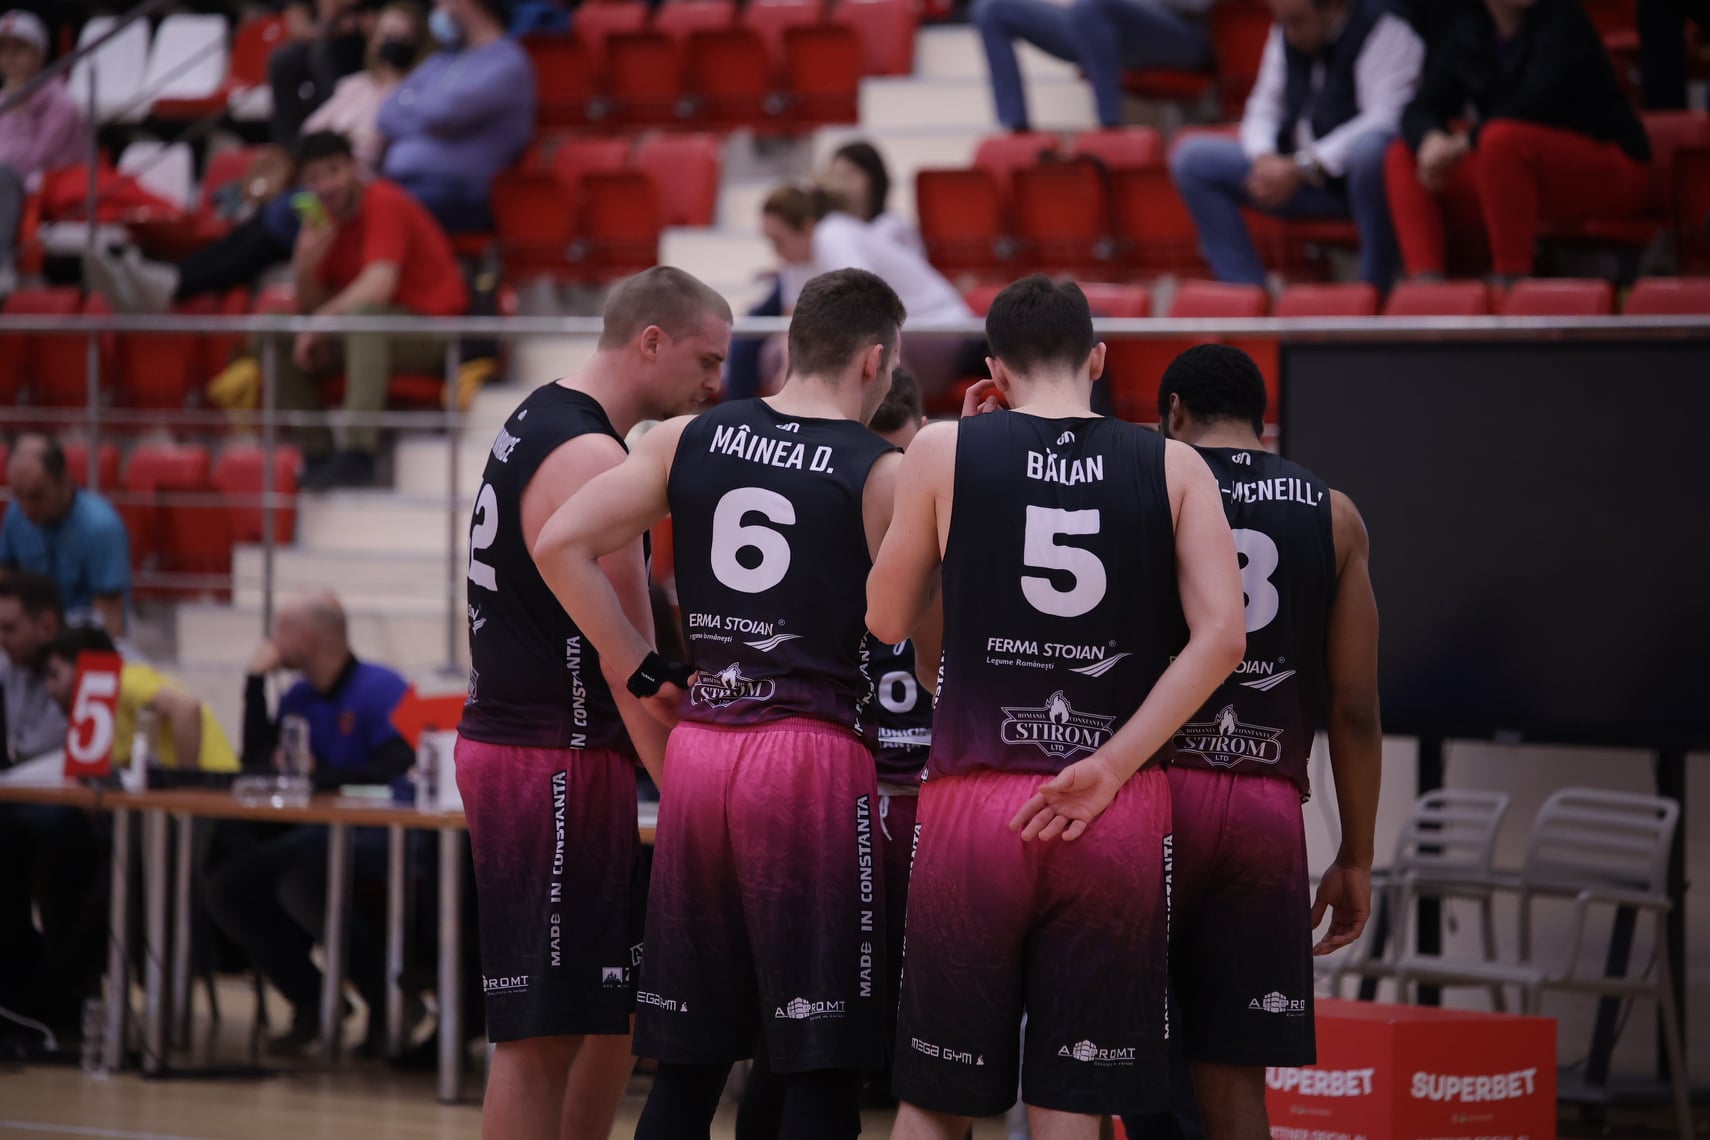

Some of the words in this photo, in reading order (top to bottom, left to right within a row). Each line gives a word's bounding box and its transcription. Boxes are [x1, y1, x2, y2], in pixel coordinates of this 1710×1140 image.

[709, 424, 805, 470] MÂINEA
[809, 446, 834, 474] D.
[711, 486, 797, 593] 6
[1021, 505, 1107, 618] 5
[689, 613, 721, 629] ERMA
[724, 617, 774, 636] STOIAN
[987, 637, 1039, 655] FERMA
[1043, 642, 1105, 660] STOIAN
[986, 656, 1014, 667] Legume
[1233, 660, 1274, 675] OIAN
[68, 671, 115, 763] 5
[1017, 712, 1047, 720] ROMANIA
[1016, 723, 1100, 748] STIROM
[1050, 743, 1065, 751] LTD
[1183, 736, 1267, 758] STIROM
[1215, 754, 1230, 762] LTD
[552, 771, 567, 875] CONSTANTA
[857, 795, 873, 903] CONSTANTA
[551, 882, 562, 903] IN
[861, 910, 873, 931] IN
[550, 912, 562, 967] MADE
[860, 940, 873, 997] MADE
[943, 1048, 972, 1065] GYM
[1266, 1067, 1375, 1097] UPERBET
[1410, 1067, 1537, 1103] SUPERBET
